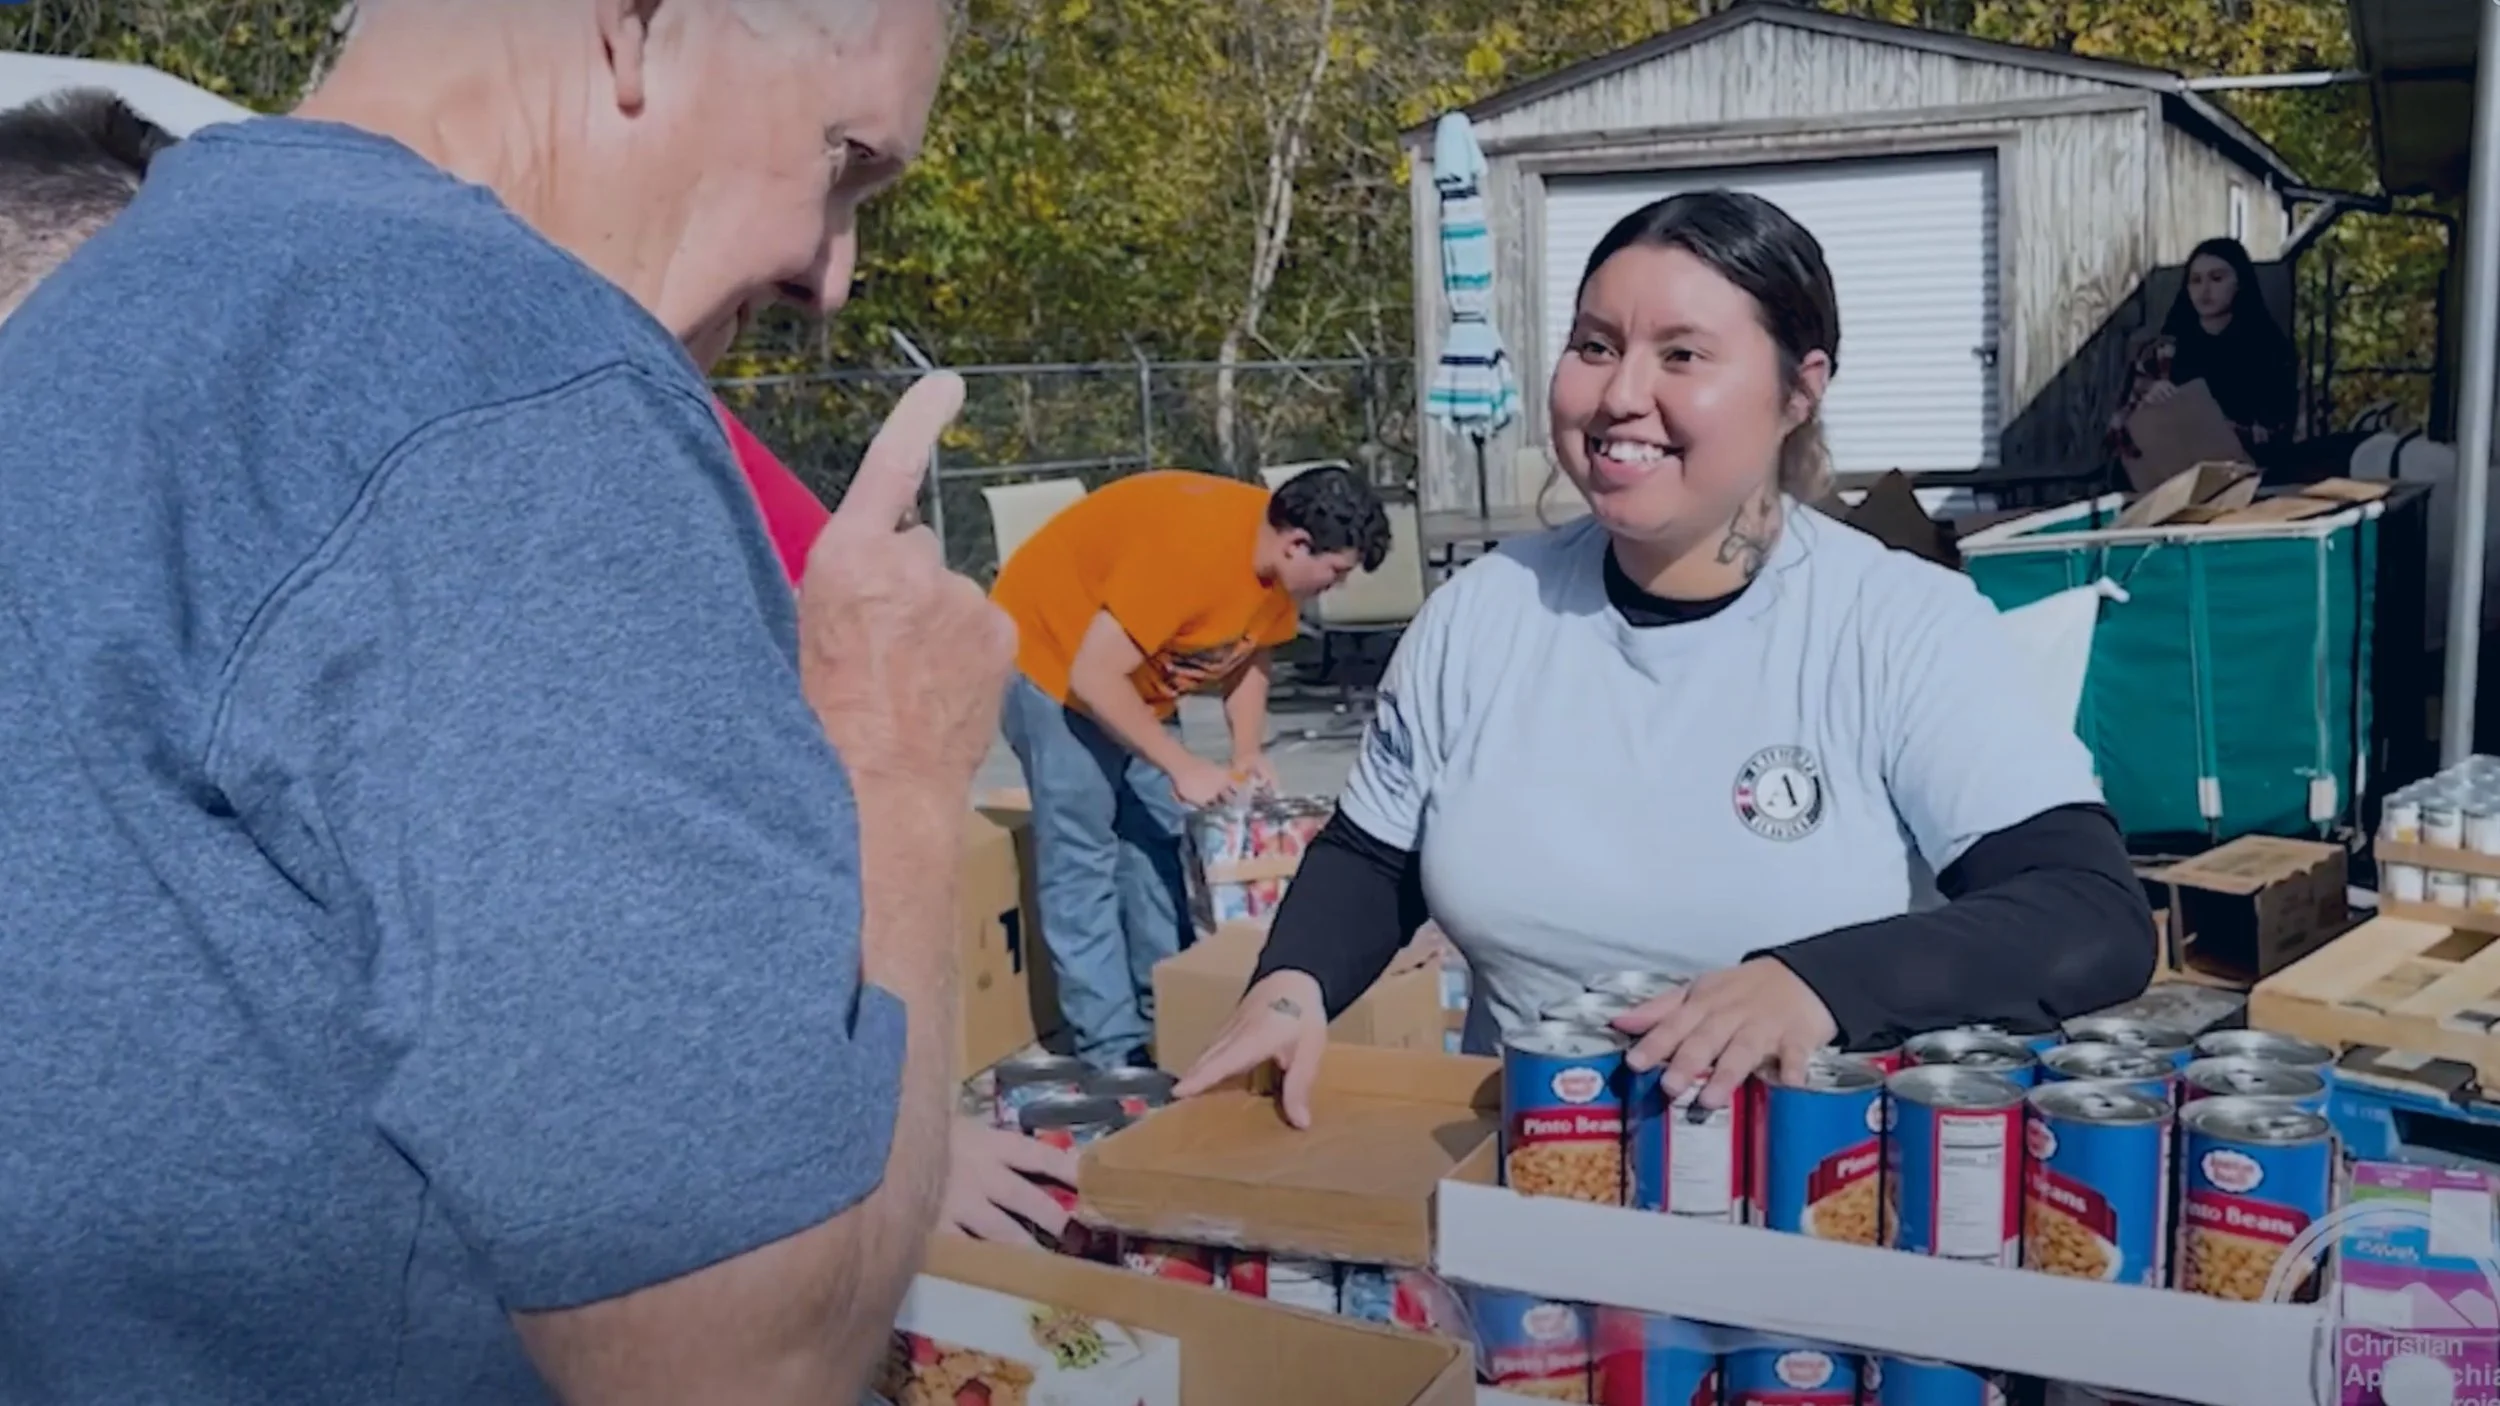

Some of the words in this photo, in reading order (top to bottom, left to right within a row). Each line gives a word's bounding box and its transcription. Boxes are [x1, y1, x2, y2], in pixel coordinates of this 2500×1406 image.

[1523, 1118, 1574, 1136] Pinto
[1575, 1115, 1622, 1134] Bean
[2186, 1202, 2222, 1223] nto
[2225, 1205, 2296, 1236] Beans
